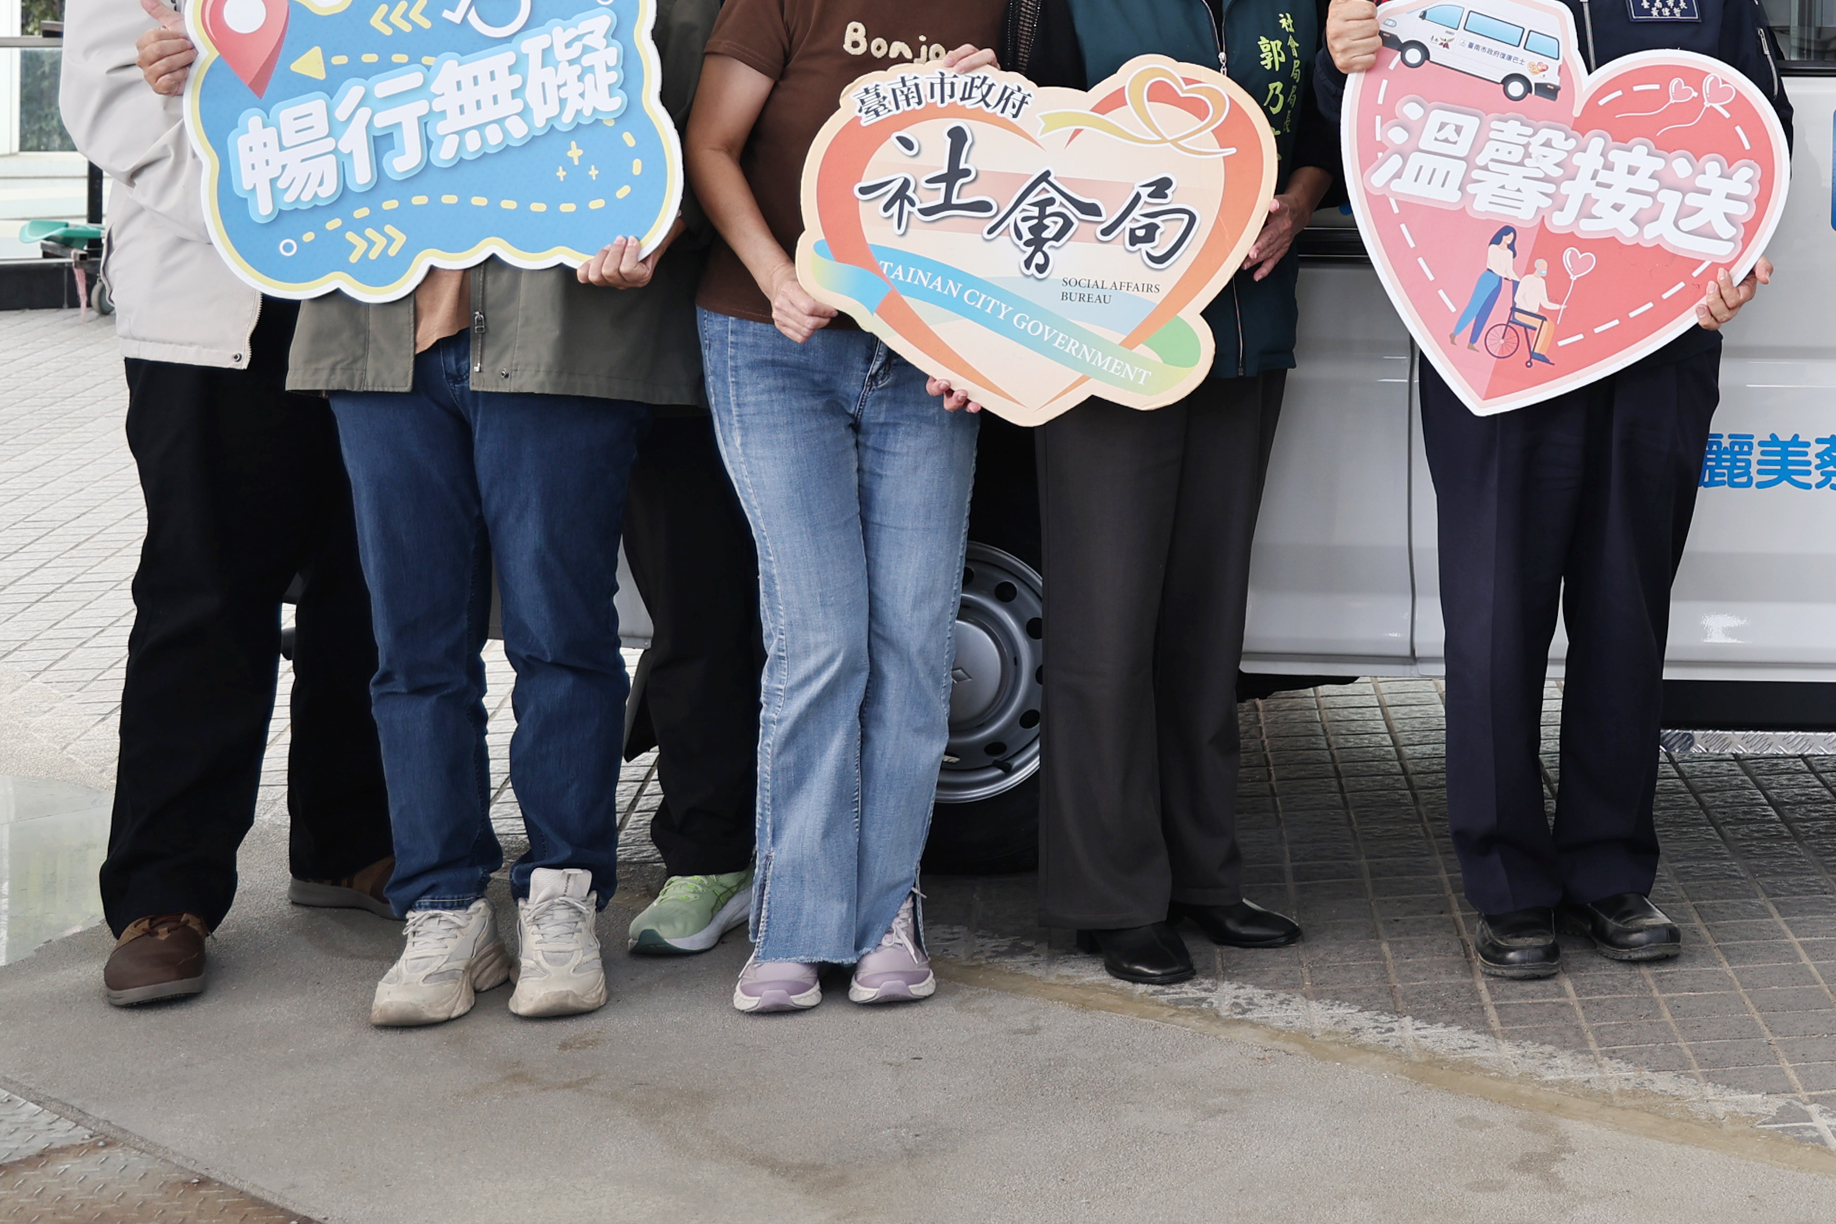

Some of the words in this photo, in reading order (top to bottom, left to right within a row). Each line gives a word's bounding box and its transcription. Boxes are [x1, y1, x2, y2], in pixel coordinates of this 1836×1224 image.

[843, 21, 955, 64] Bonjo
[856, 71, 1030, 124] 臺南市政府
[1257, 36, 1287, 160] 郭乃
[1278, 12, 1301, 133] 社會局局長
[238, 14, 622, 217] 暢行無礙
[858, 125, 1198, 274] 社會局
[1371, 102, 1755, 256] 溫馨接送
[879, 260, 962, 298] TAINAN
[963, 288, 1013, 320] CITY
[1013, 312, 1151, 386] GOVERNMENT
[1061, 291, 1112, 304] BUREAU
[1062, 277, 1107, 289] SOCIAL
[1110, 281, 1160, 293] AFFAIRS
